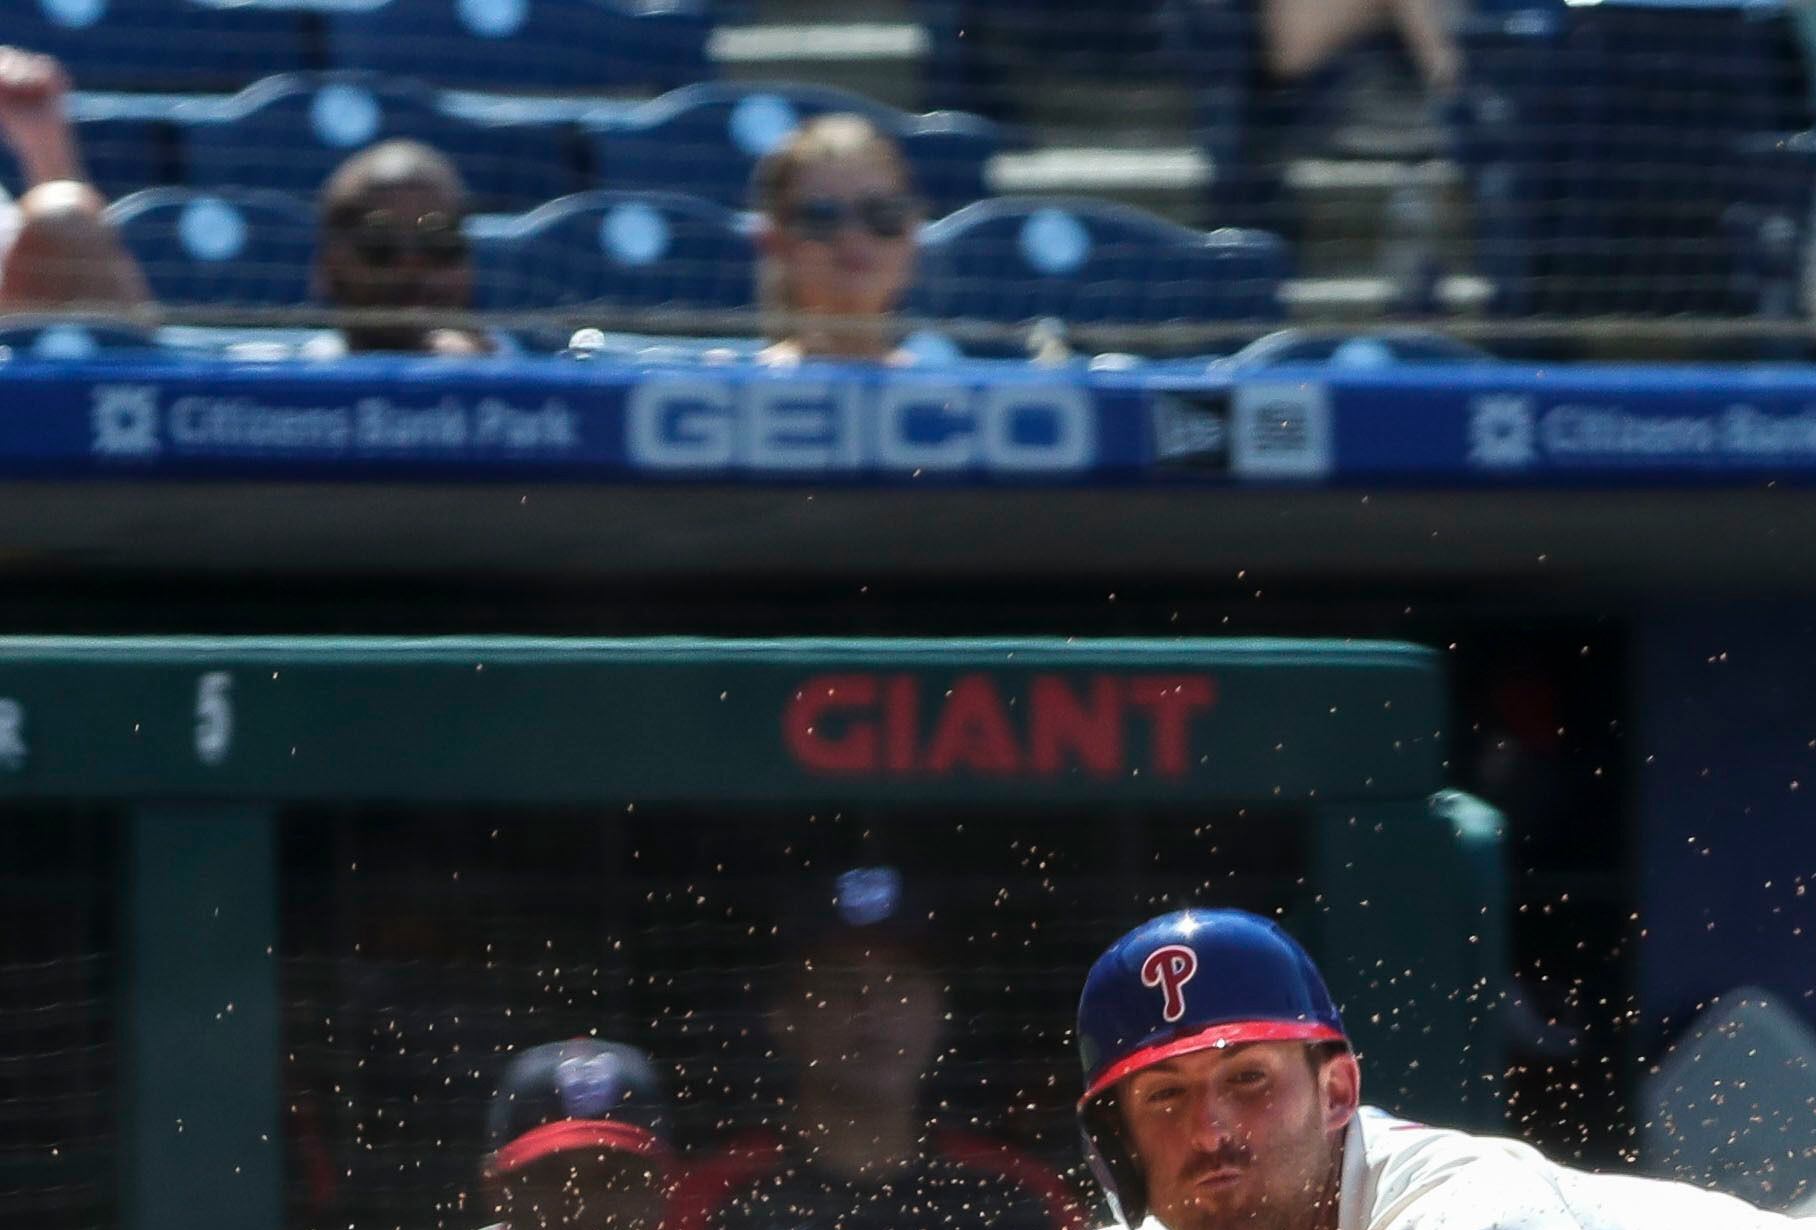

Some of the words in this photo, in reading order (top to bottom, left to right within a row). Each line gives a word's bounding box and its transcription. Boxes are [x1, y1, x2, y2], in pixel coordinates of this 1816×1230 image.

[356, 396, 466, 448] Bank
[476, 396, 576, 448] Park
[626, 378, 1096, 471] GEICO
[194, 669, 234, 765] 5
[783, 673, 1217, 777] GIANT
[1141, 944, 1198, 1022] P
